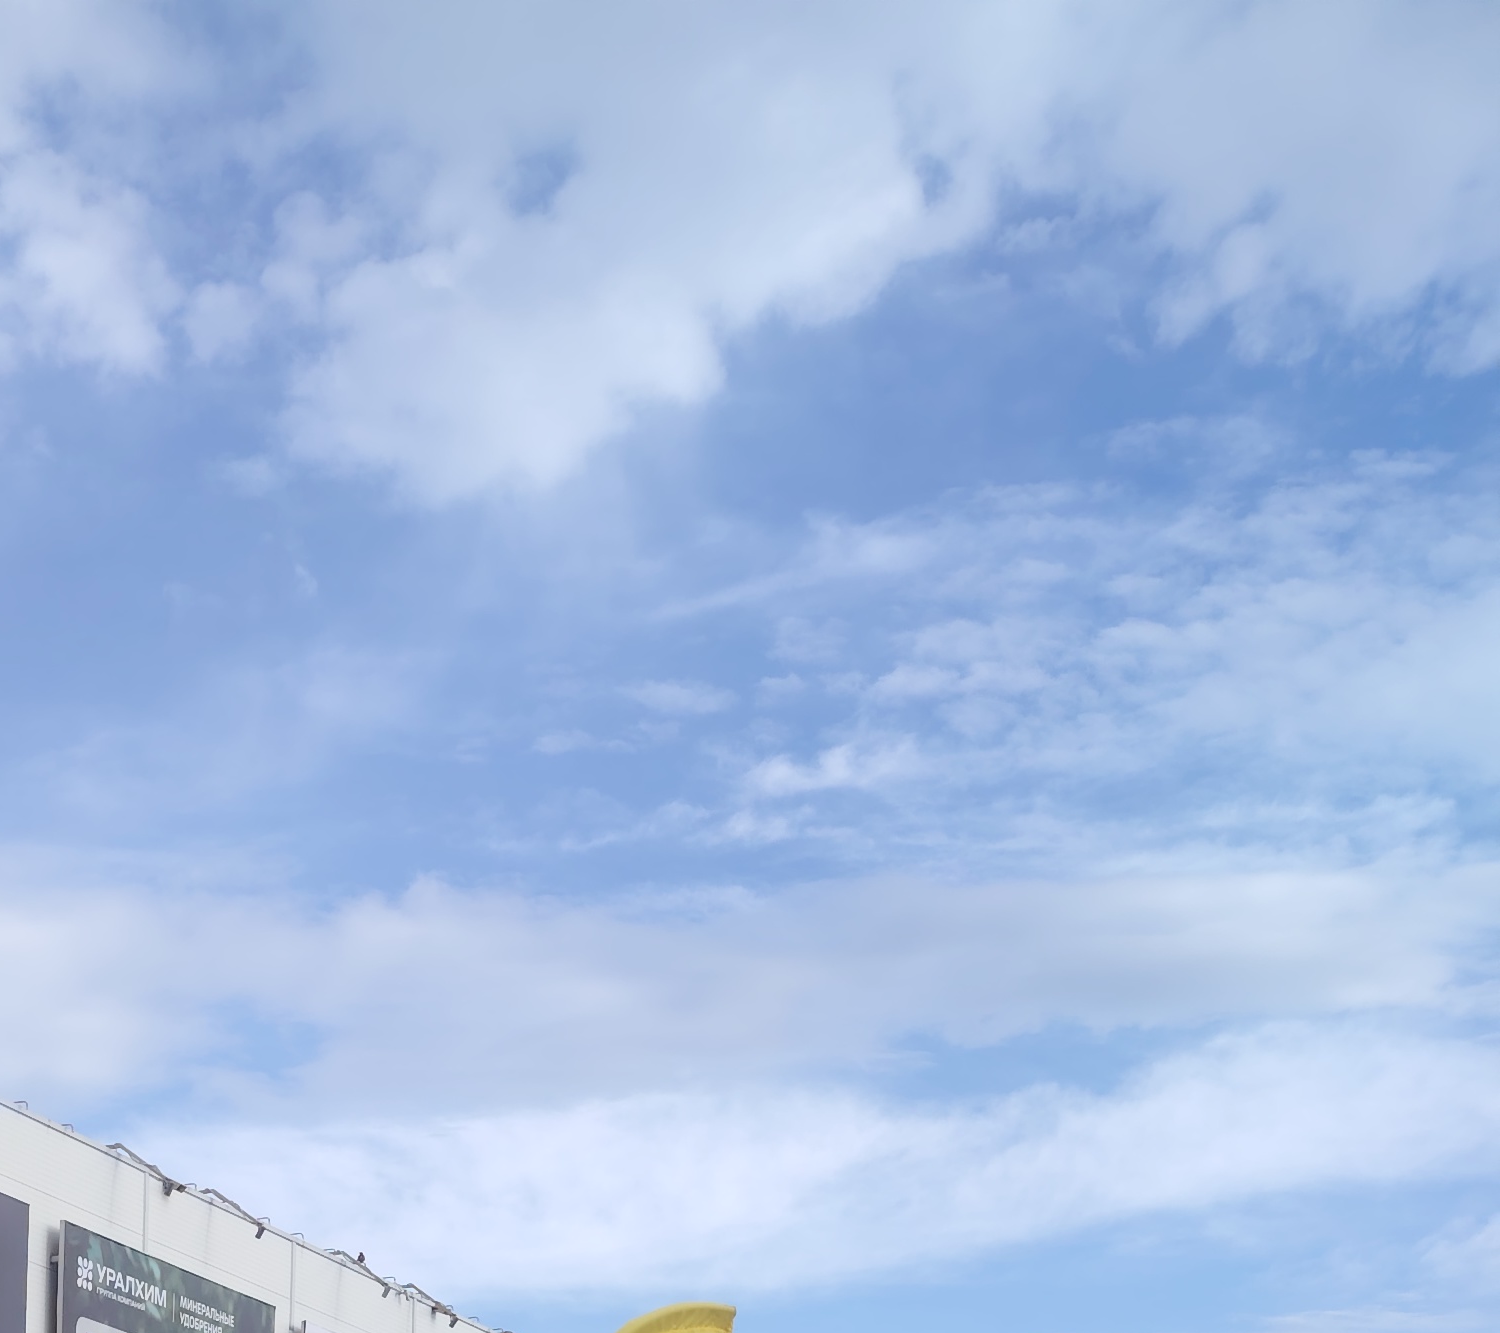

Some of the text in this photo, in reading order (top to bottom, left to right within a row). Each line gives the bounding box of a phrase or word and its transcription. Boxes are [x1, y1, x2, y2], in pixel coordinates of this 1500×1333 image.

[96, 1263, 167, 1308] УРАЛХИМ
[96, 1286, 117, 1301] ГРУППА
[180, 1296, 235, 1328] МИНЕРАЛЬНЫЕ
